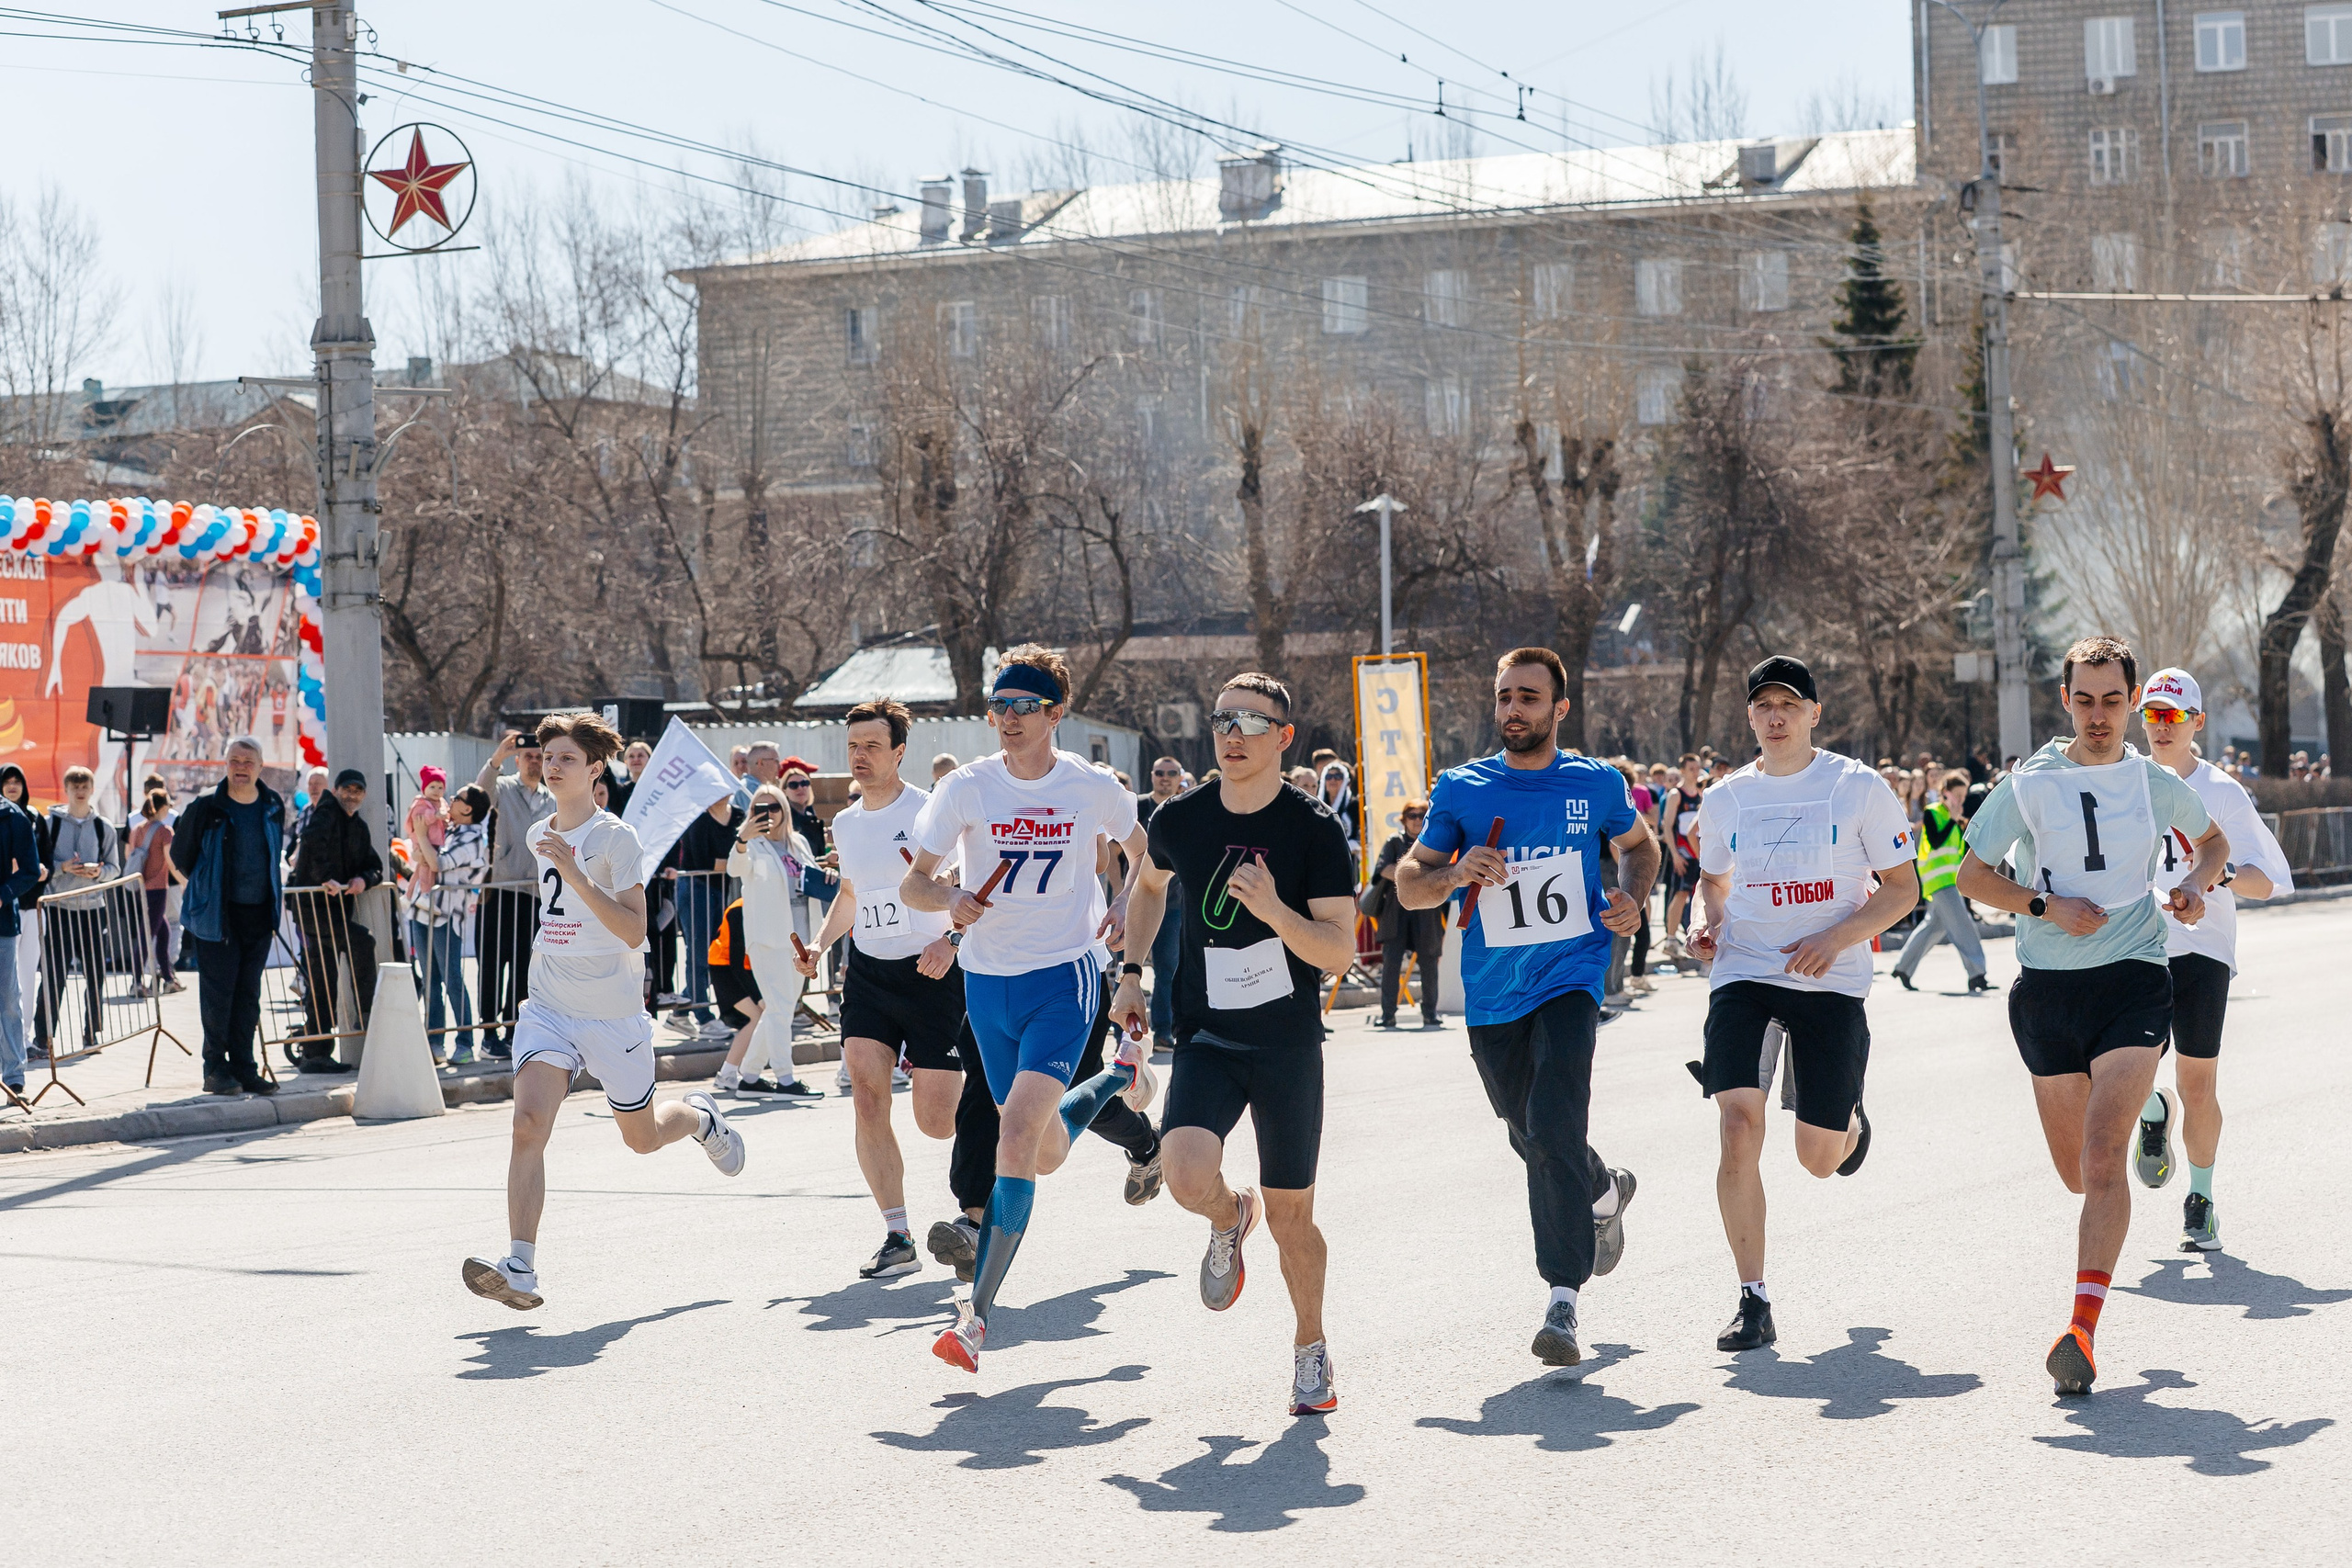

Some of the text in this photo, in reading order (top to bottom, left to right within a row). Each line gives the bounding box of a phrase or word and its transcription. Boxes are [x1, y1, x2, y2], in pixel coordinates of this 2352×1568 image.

[0, 552, 45, 581] СКАЯ
[2147, 684, 2183, 695] Red Bull
[991, 818, 1074, 840] ГРАНИТ
[1566, 823, 1588, 834] ЛУЧ
[1761, 817, 1802, 872] 7
[1000, 850, 1063, 895] 77
[543, 867, 565, 916] 2
[1502, 873, 1568, 930] 16
[1771, 878, 1835, 908] С ТОБОЙ
[862, 902, 899, 929] 212
[1224, 966, 1273, 983] ОБЩЕВОЙСКОВАЯ
[1240, 978, 1260, 989] АРМИЯ
